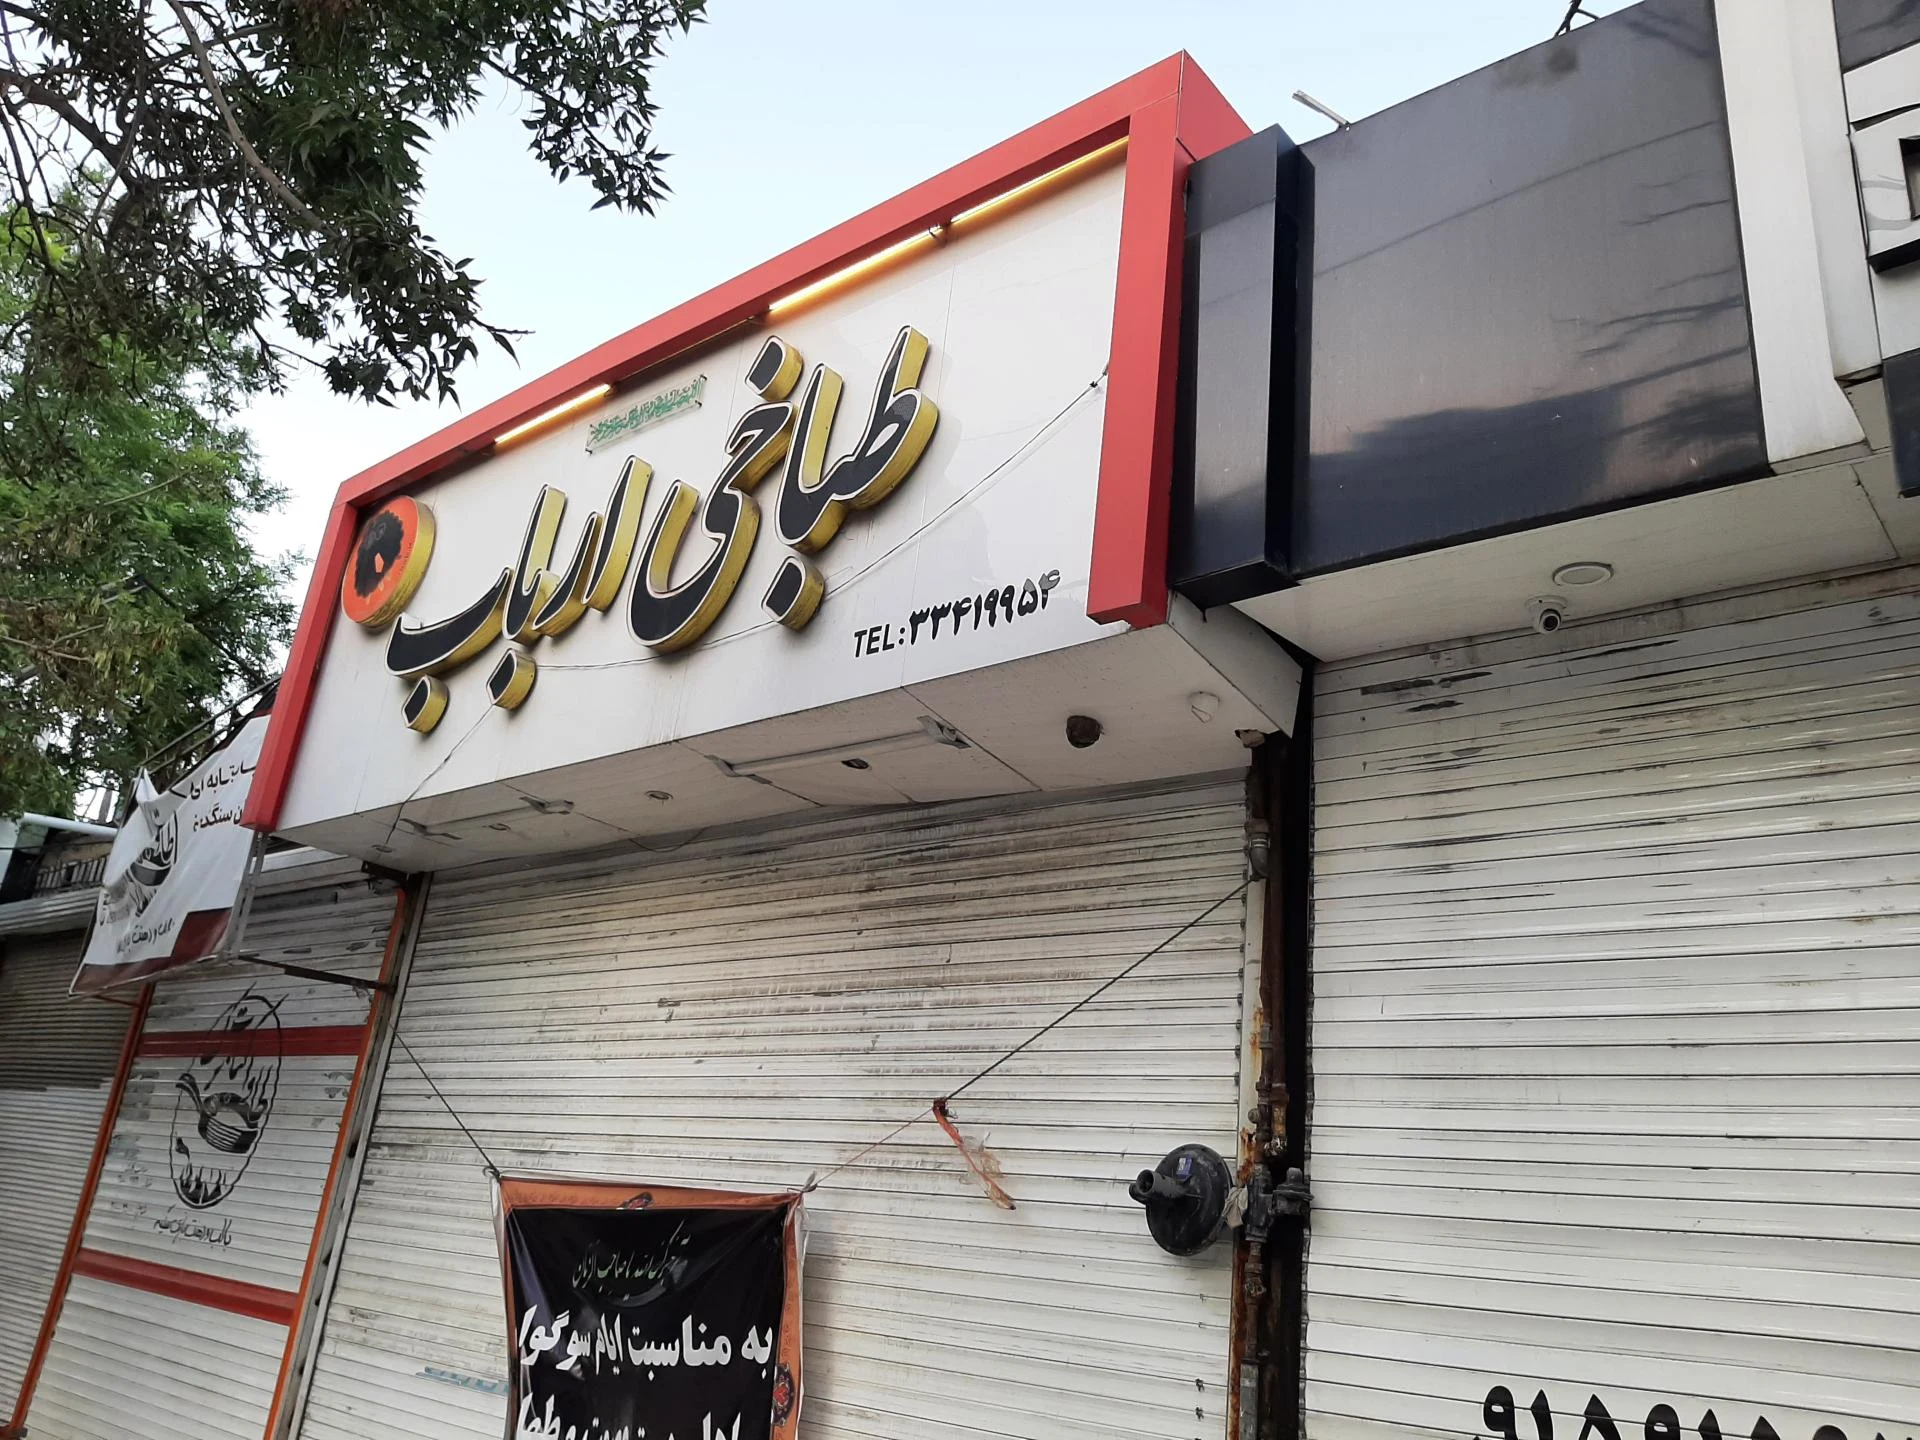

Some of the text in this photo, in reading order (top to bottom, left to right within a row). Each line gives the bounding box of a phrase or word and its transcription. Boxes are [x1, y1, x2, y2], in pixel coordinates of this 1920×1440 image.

[385, 325, 938, 733] طباخی ارباب
[595, 1312, 624, 1376] ایام
[627, 1314, 732, 1382] مناسبت
[741, 1325, 773, 1380] به
